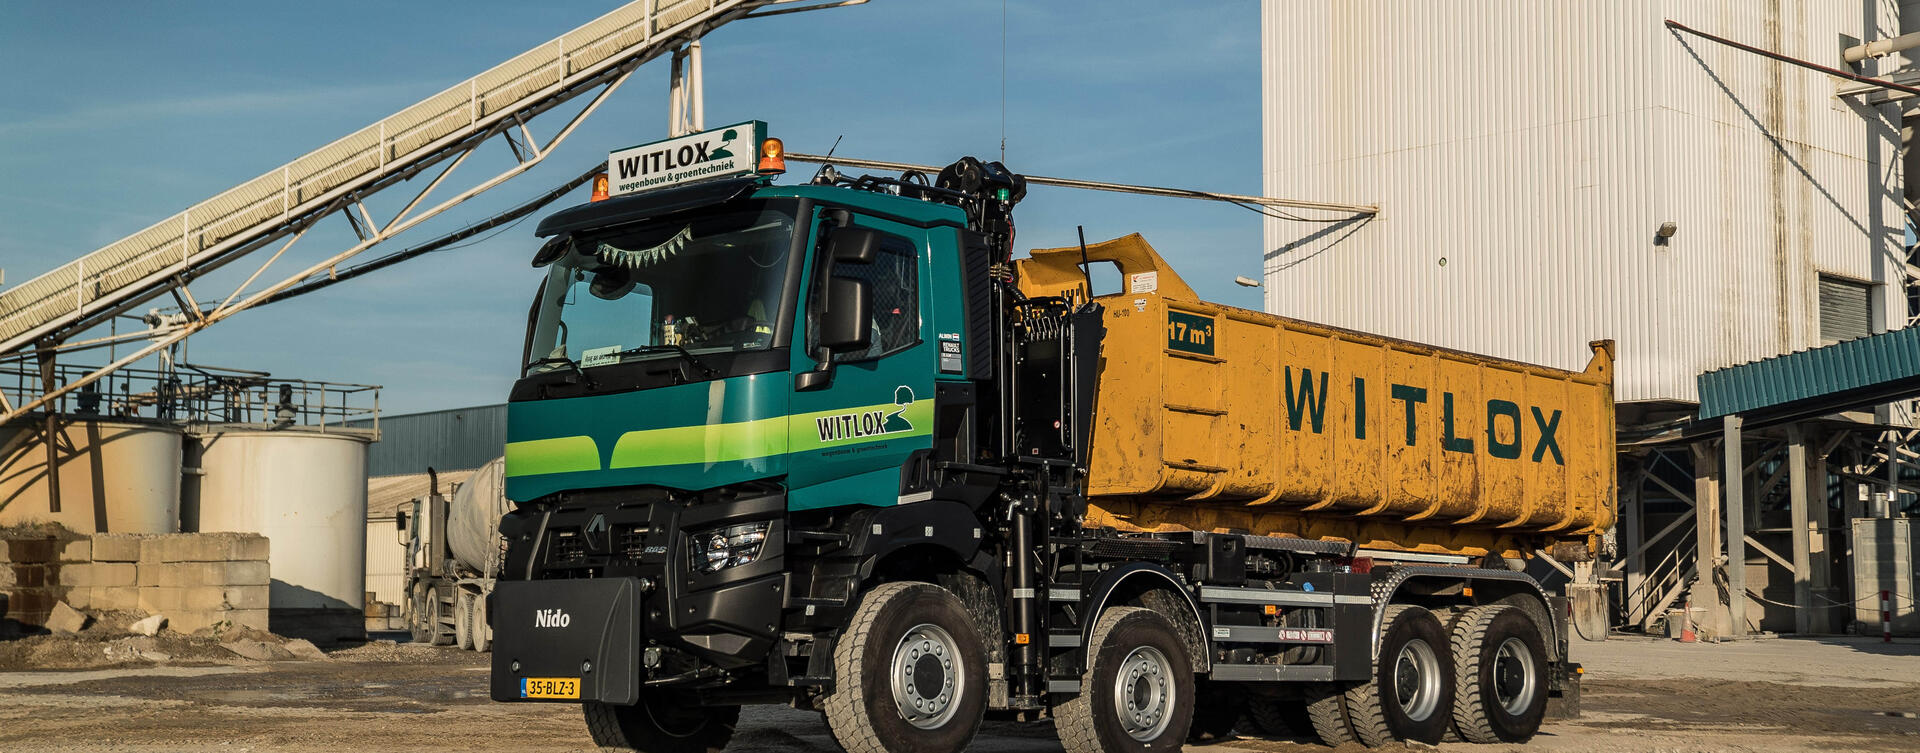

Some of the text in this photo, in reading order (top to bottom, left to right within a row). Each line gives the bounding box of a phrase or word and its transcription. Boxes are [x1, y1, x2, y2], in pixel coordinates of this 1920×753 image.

[617, 140, 710, 180] WITLOX
[619, 160, 735, 192] wegenbouw & groentechniek
[1168, 321, 1187, 341] 17
[816, 411, 885, 442] WITLOX
[1284, 365, 1566, 466] WITLOX
[535, 608, 570, 628] Nido
[529, 681, 575, 695] 35-BLZ-3
